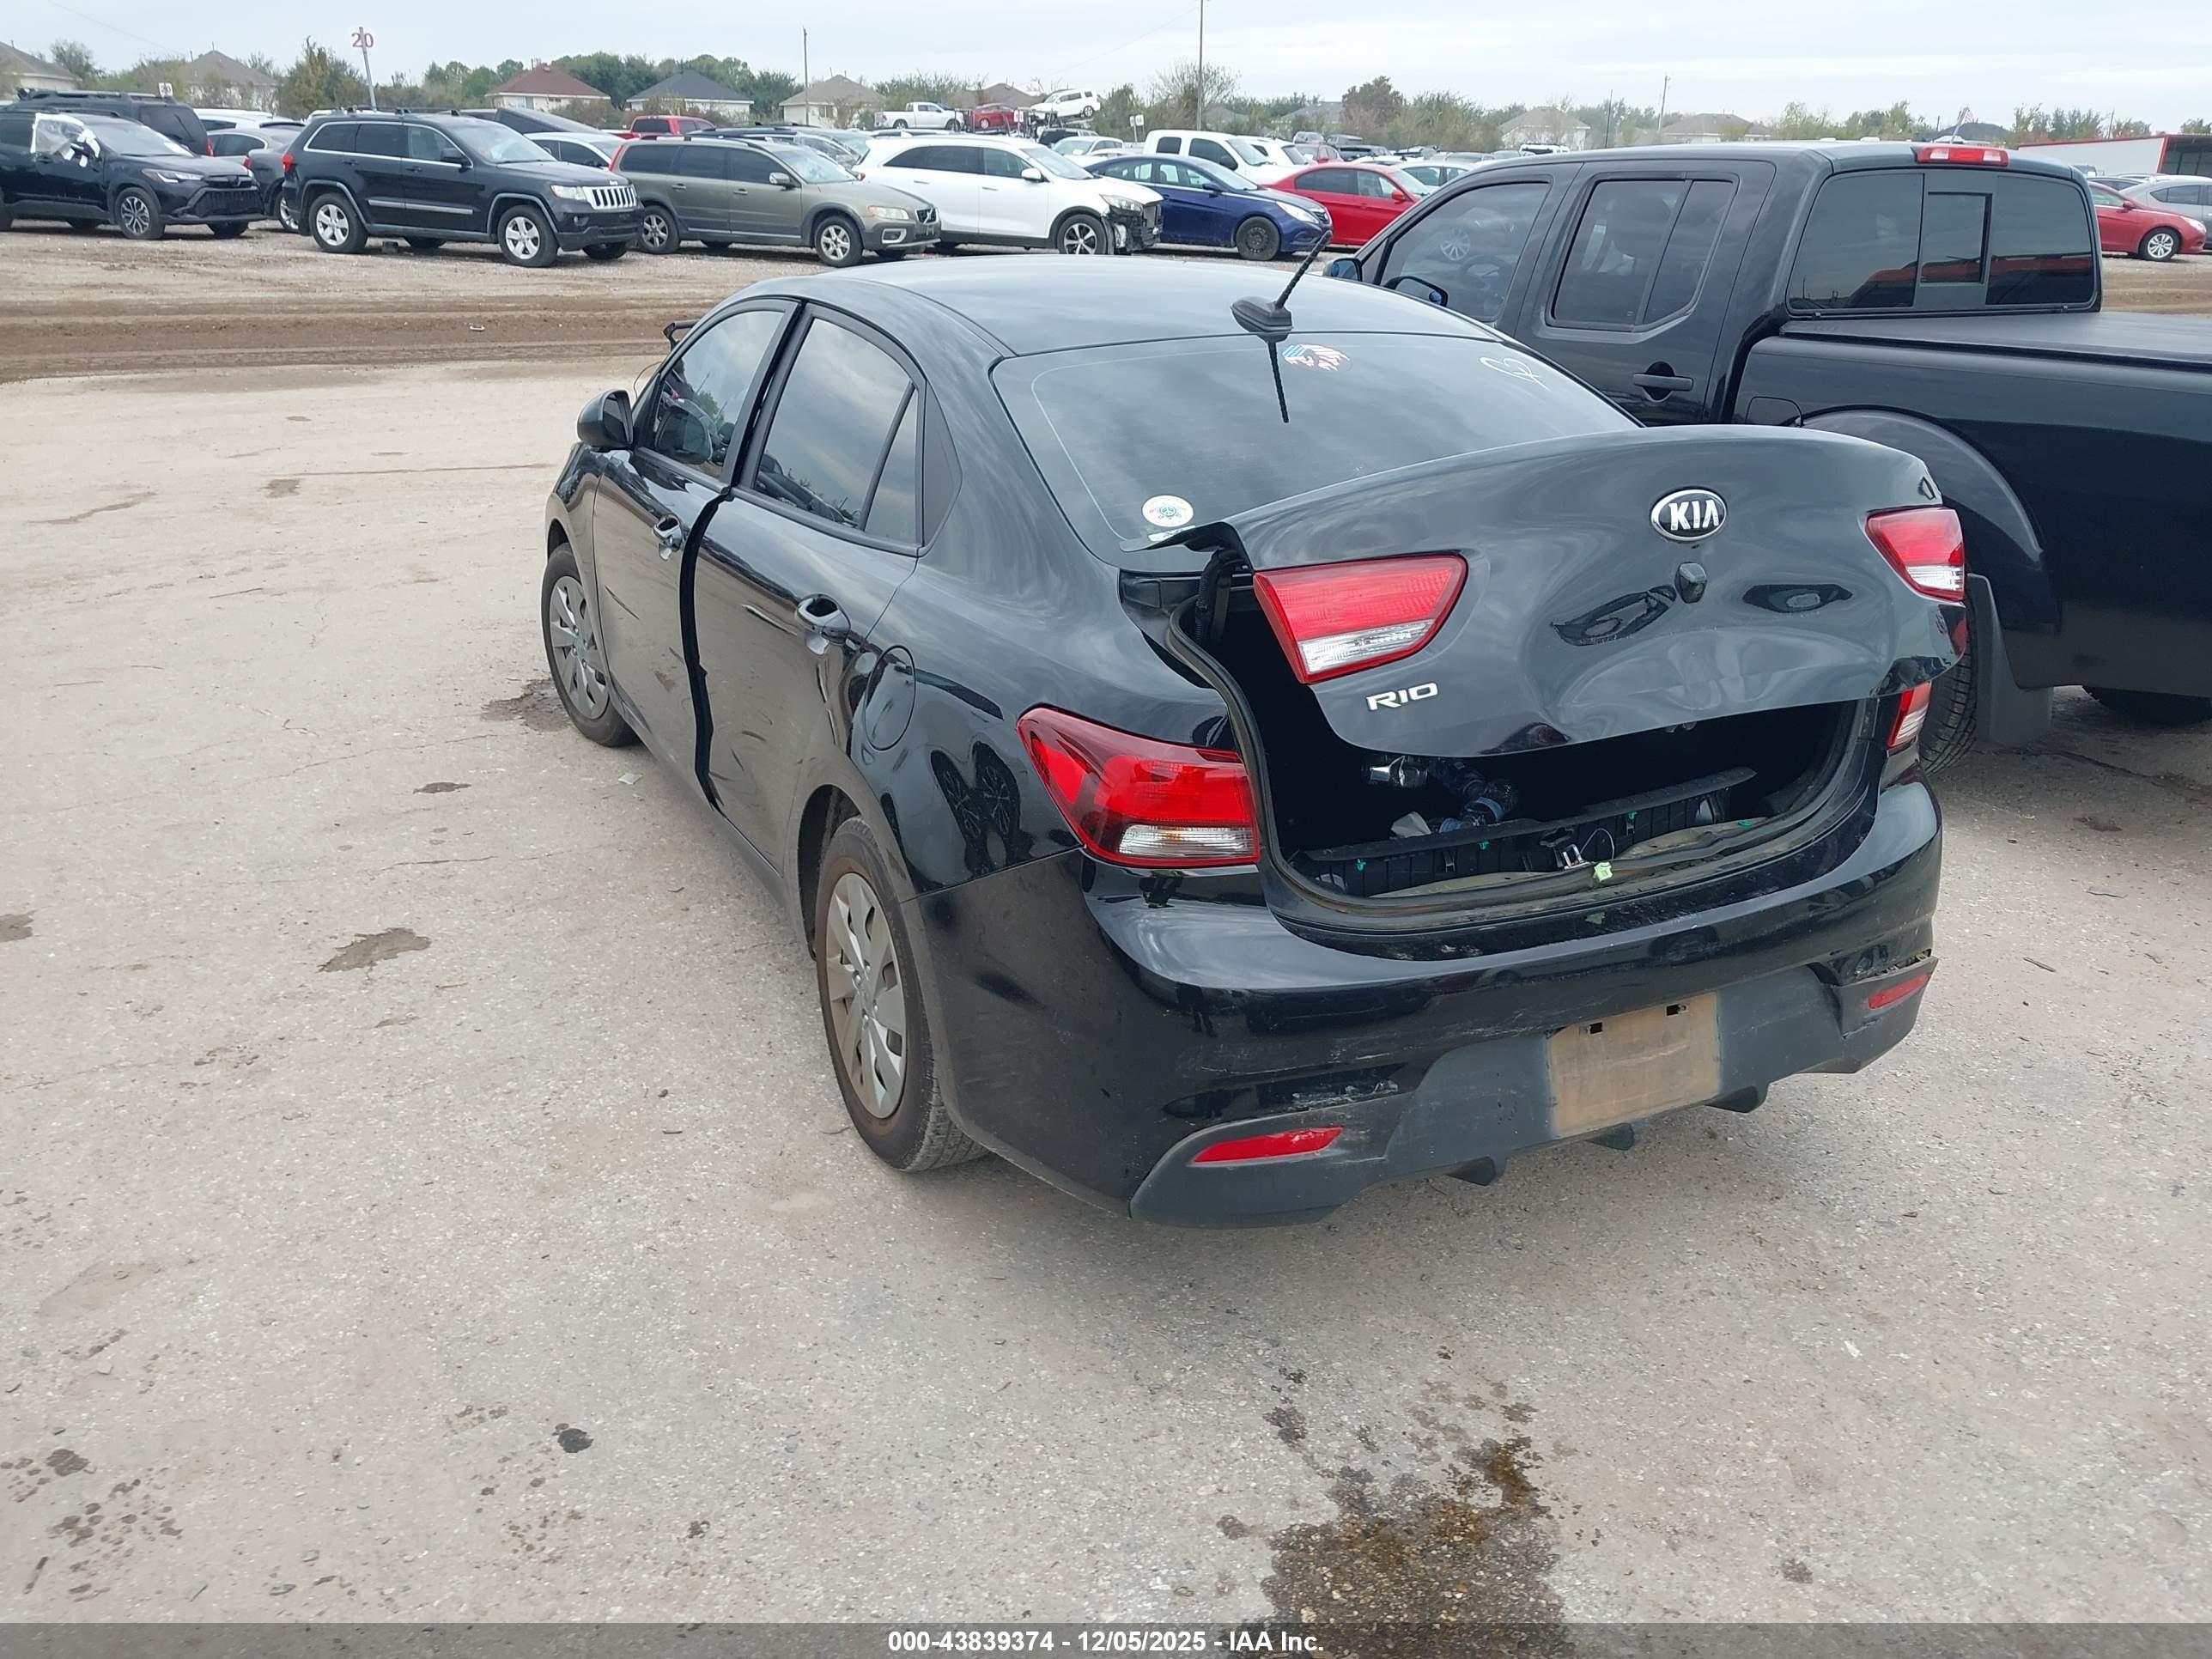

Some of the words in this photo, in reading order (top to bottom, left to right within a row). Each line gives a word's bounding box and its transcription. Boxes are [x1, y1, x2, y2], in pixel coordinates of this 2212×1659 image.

[351, 33, 374, 48] 20
[1668, 499, 1719, 531] KIA
[1366, 683, 1438, 711] RIO
